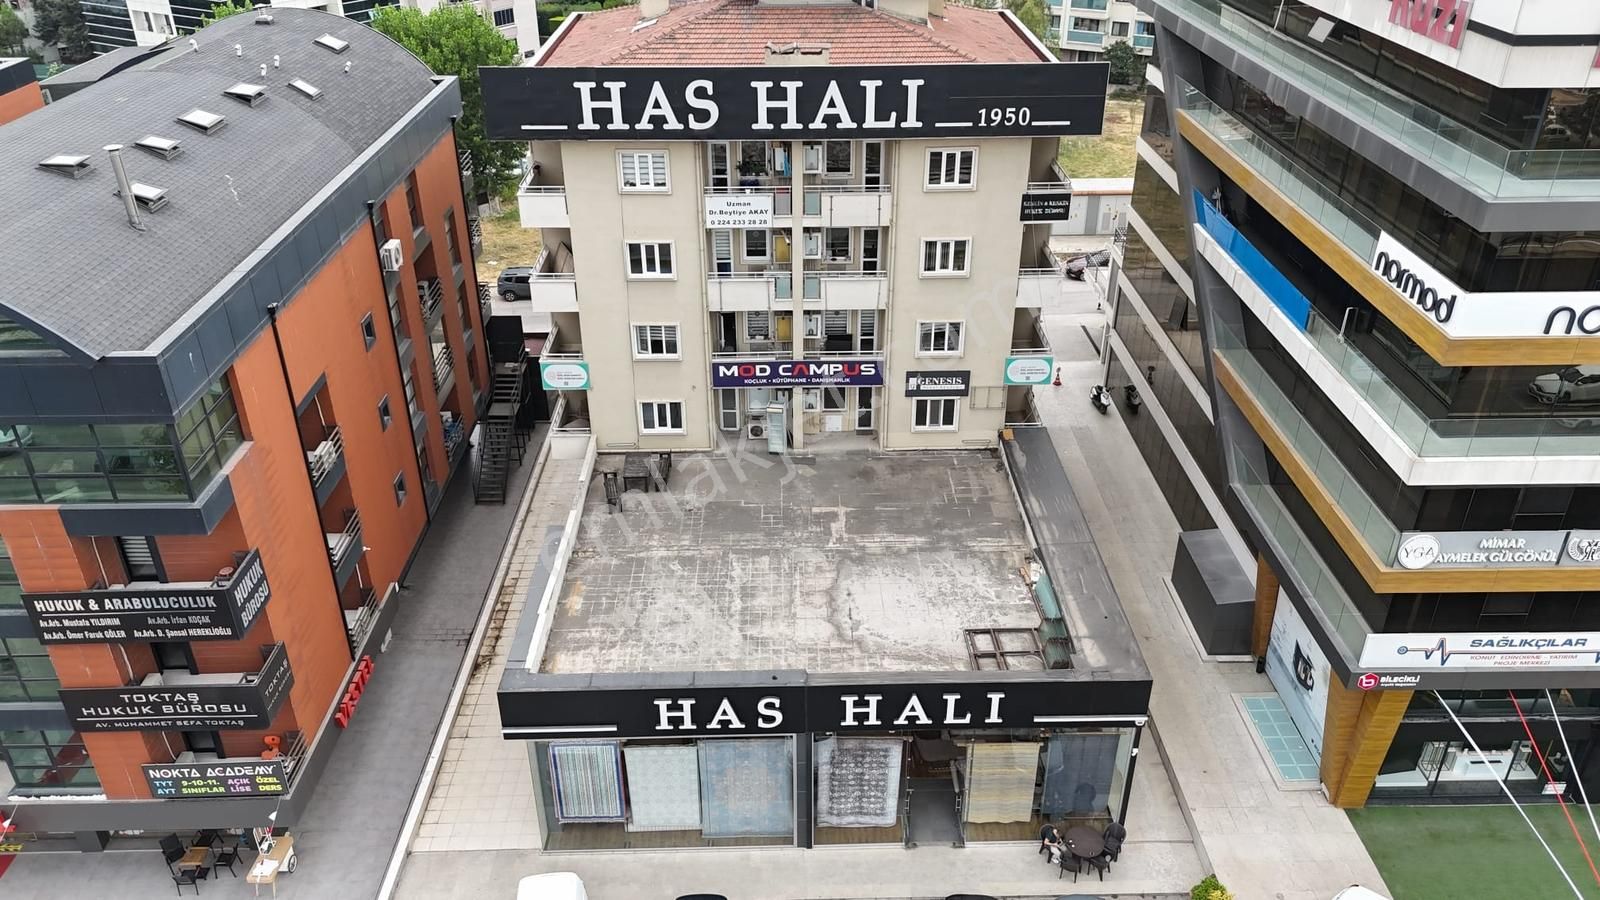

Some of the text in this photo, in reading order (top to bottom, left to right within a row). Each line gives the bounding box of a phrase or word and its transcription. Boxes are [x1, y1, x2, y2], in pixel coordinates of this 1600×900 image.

[573, 79, 925, 131] HAS HALI
[977, 107, 1032, 127] 1950
[1375, 251, 1458, 323] normod
[719, 363, 876, 377] MOD CAMPUS
[917, 376, 962, 385] GENESIS
[1479, 537, 1527, 549] MİMAR
[1404, 547, 1435, 559] YGA
[1435, 552, 1489, 563] AYMELEK
[1489, 549, 1558, 562] GÜLGÖNÜL
[234, 558, 263, 607] HUKUK
[34, 596, 217, 612] HUKUK & ARABULUCULUK
[241, 580, 269, 628] BÜROSU
[62, 618, 90, 627] Mustafa
[89, 617, 121, 626] YILDIRIM
[188, 615, 211, 625] KOÇAK
[66, 630, 84, 639] Ömer
[84, 630, 104, 639] Faruk
[1470, 636, 1588, 649] SAĞLIKÇILAR
[264, 658, 288, 697] TOKTAŞ
[119, 692, 200, 704] TOKTAŞ
[82, 703, 247, 716] HUKUK BÜROSU
[653, 692, 1006, 730] HAS HALI
[114, 720, 173, 728] MUHAMMET
[148, 765, 274, 779] NOKTA ACADEMY
[227, 778, 251, 786] AÇIK
[255, 775, 280, 783] ÖZEL
[182, 786, 226, 794] SINIFLAR
[230, 785, 252, 793] LİSE
[259, 784, 283, 792] DERS
